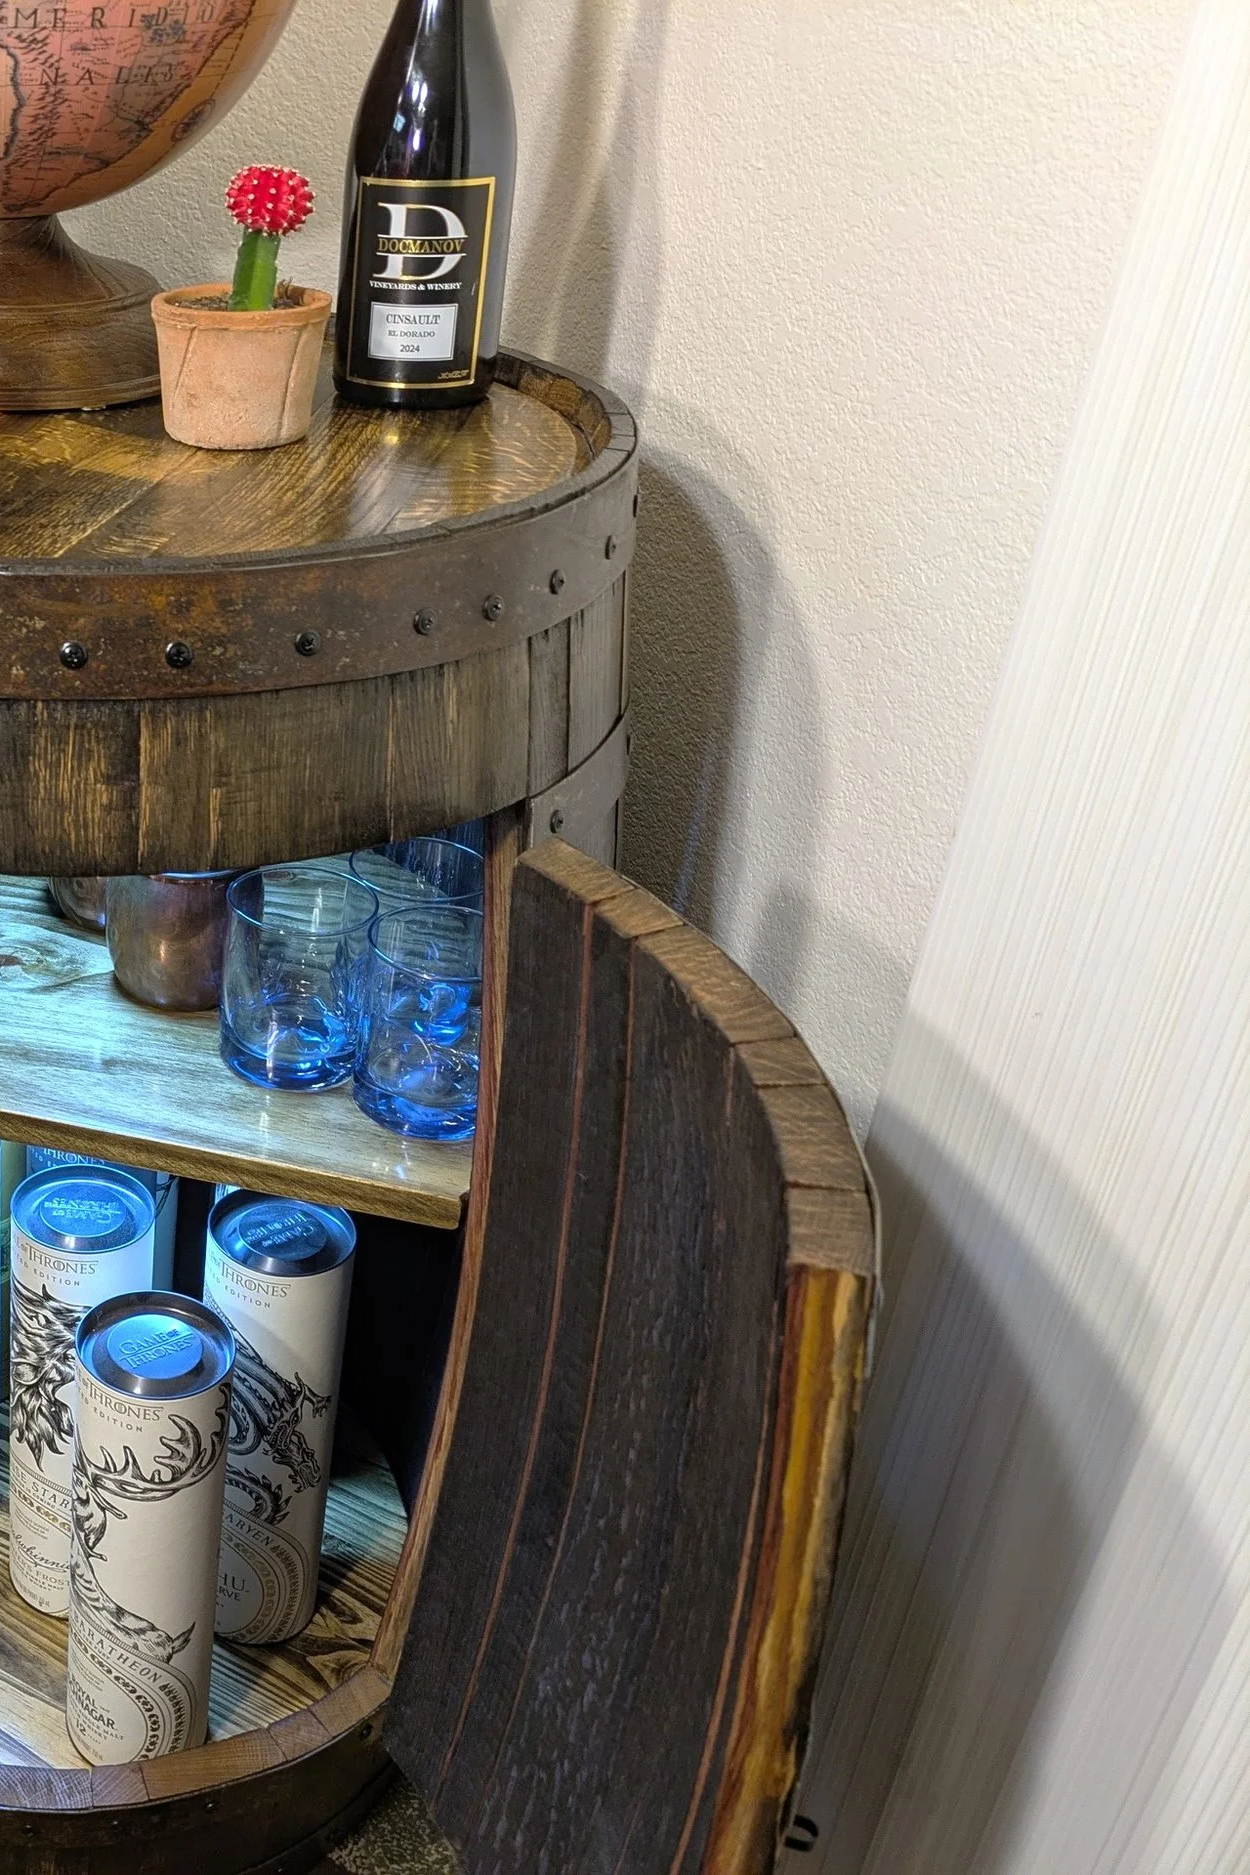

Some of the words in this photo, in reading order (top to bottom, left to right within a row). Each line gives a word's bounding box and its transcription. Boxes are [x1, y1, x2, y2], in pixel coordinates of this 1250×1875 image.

[378, 238, 465, 254] DOCMANOV
[369, 280, 417, 291] VINEYARDS
[417, 283, 426, 291] &
[427, 282, 462, 291] WINERY
[385, 313, 441, 325] CINSAULT
[399, 345, 420, 353] 2024
[27, 1243, 97, 1275] THRONES
[33, 1268, 81, 1287] EDITION
[220, 1259, 290, 1298] THRONES
[224, 1285, 271, 1308] EDITION
[119, 1332, 168, 1355] GAME
[119, 1338, 193, 1370] THRONES
[87, 1378, 163, 1421] THRONES
[93, 1406, 143, 1432] EDITION
